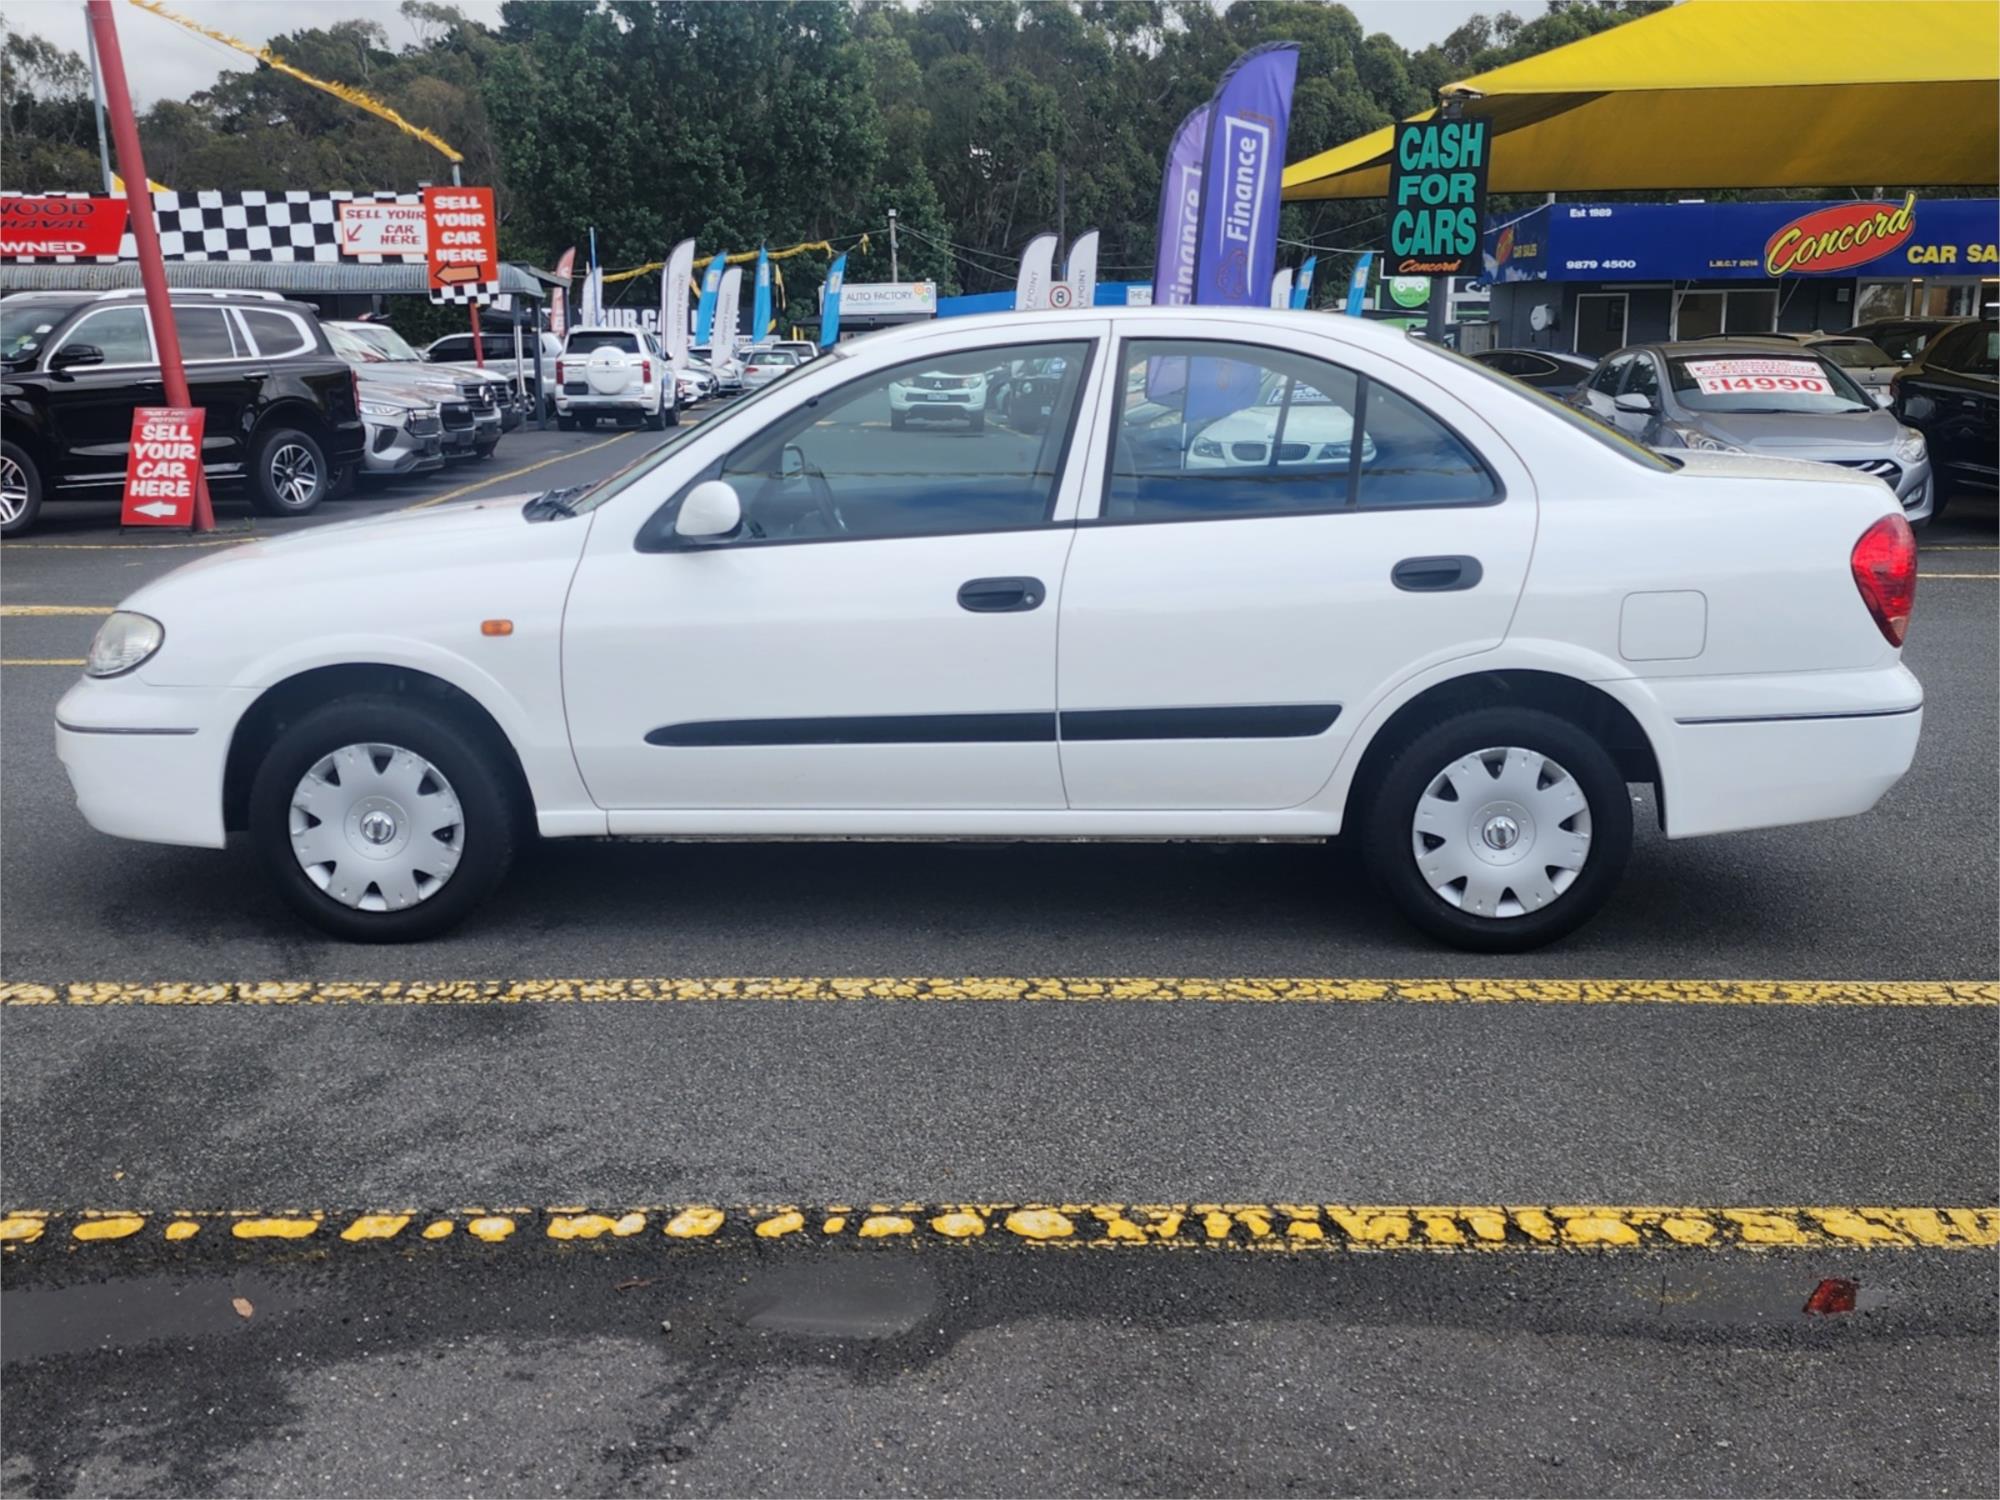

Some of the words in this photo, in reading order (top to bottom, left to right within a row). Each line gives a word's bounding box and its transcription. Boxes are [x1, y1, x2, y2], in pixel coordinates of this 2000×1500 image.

[1400, 123, 1484, 171] CASH
[1225, 136, 1257, 242] Finance
[1398, 173, 1476, 205] FOR
[433, 196, 482, 209] SELL
[346, 210, 382, 219] SELL
[387, 209, 427, 220] YOUR
[433, 213, 486, 227] YOUR
[1569, 208, 1586, 218] Est
[385, 224, 415, 235] CAR
[1391, 207, 1477, 256] CARS
[1765, 190, 1917, 278] Concord
[380, 234, 421, 245] HERE
[441, 231, 482, 245] CAR
[435, 249, 488, 263] HERE
[1906, 245, 1957, 264] CAR
[1399, 259, 1462, 273] Concord
[1566, 260, 1598, 270] 9879
[1601, 260, 1637, 270] 4500
[846, 292, 871, 301] AUTO
[874, 291, 912, 300] FACTORY
[141, 425, 193, 441] SELL
[134, 443, 197, 460] YOUR
[136, 461, 187, 478] CAR
[130, 480, 191, 497] HERE
